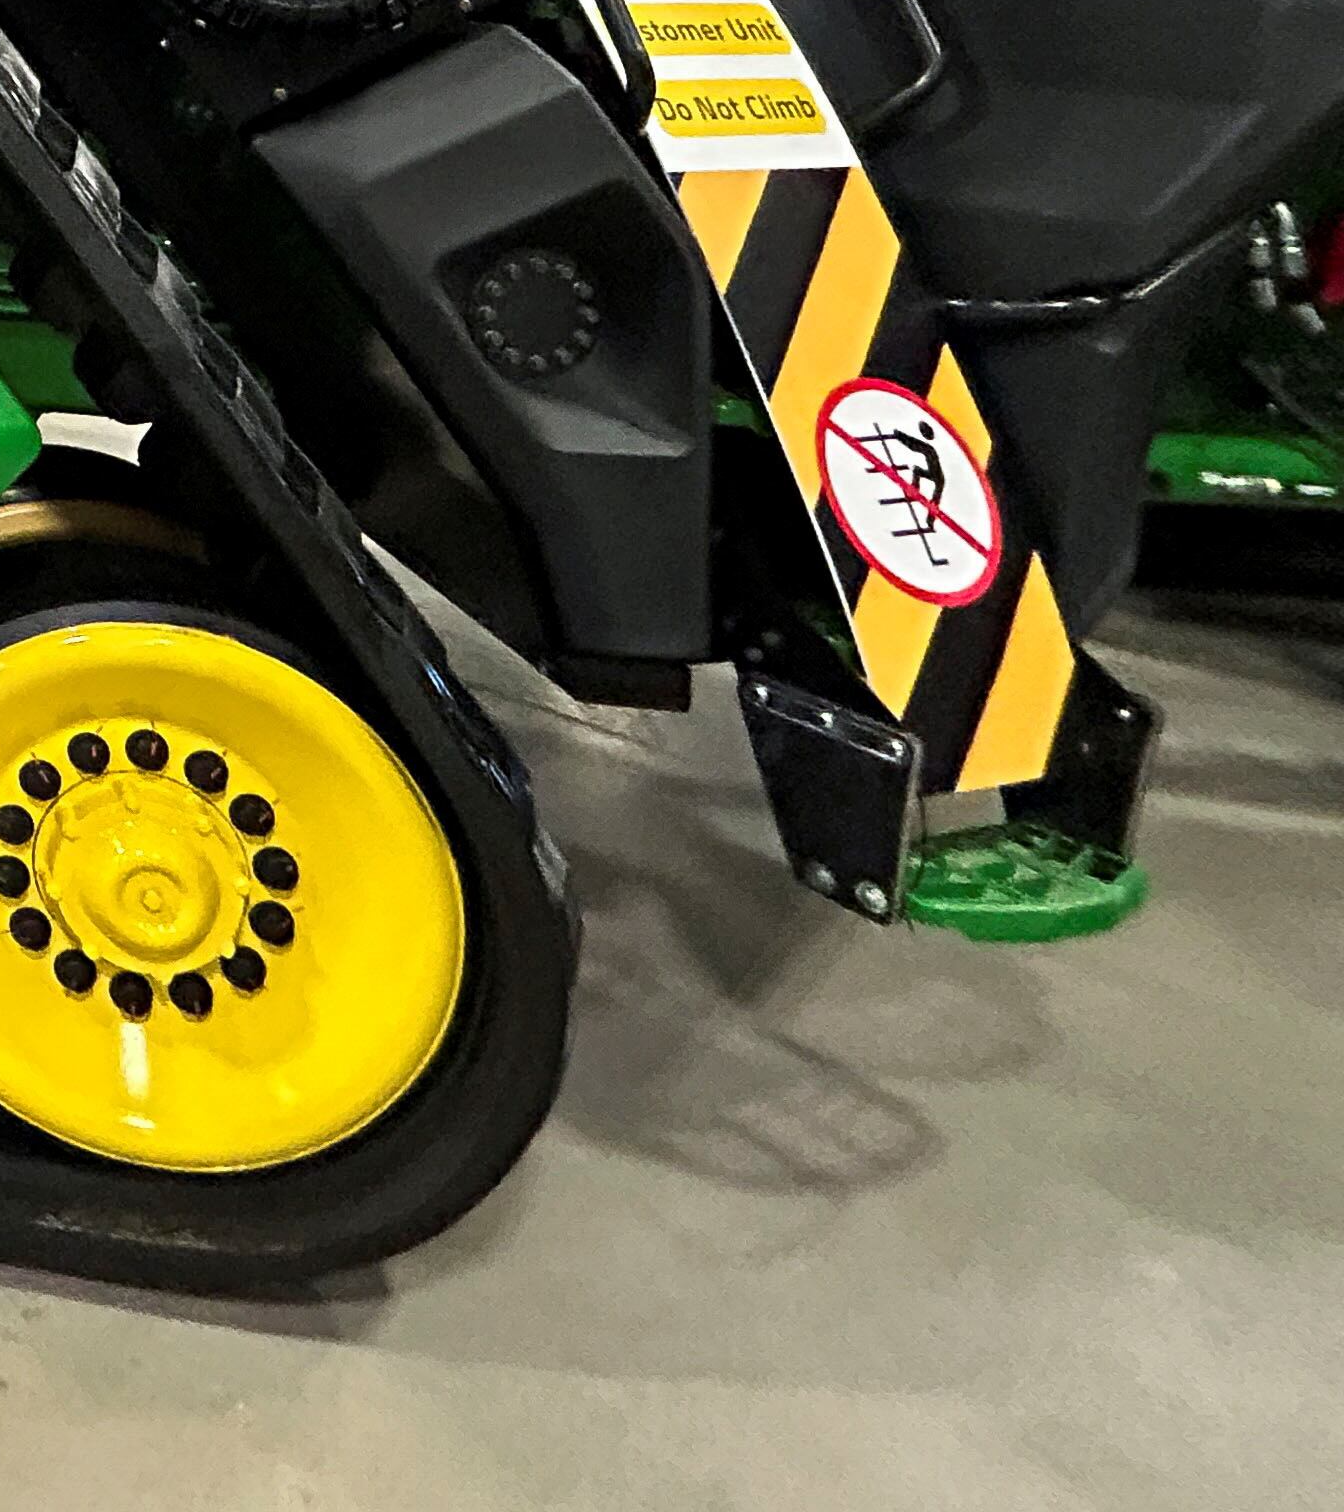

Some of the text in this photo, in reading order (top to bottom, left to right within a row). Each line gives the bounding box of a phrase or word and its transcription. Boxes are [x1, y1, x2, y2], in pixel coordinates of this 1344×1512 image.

[639, 17, 784, 42] stomer Unit
[655, 93, 817, 121] Do Not Climb
